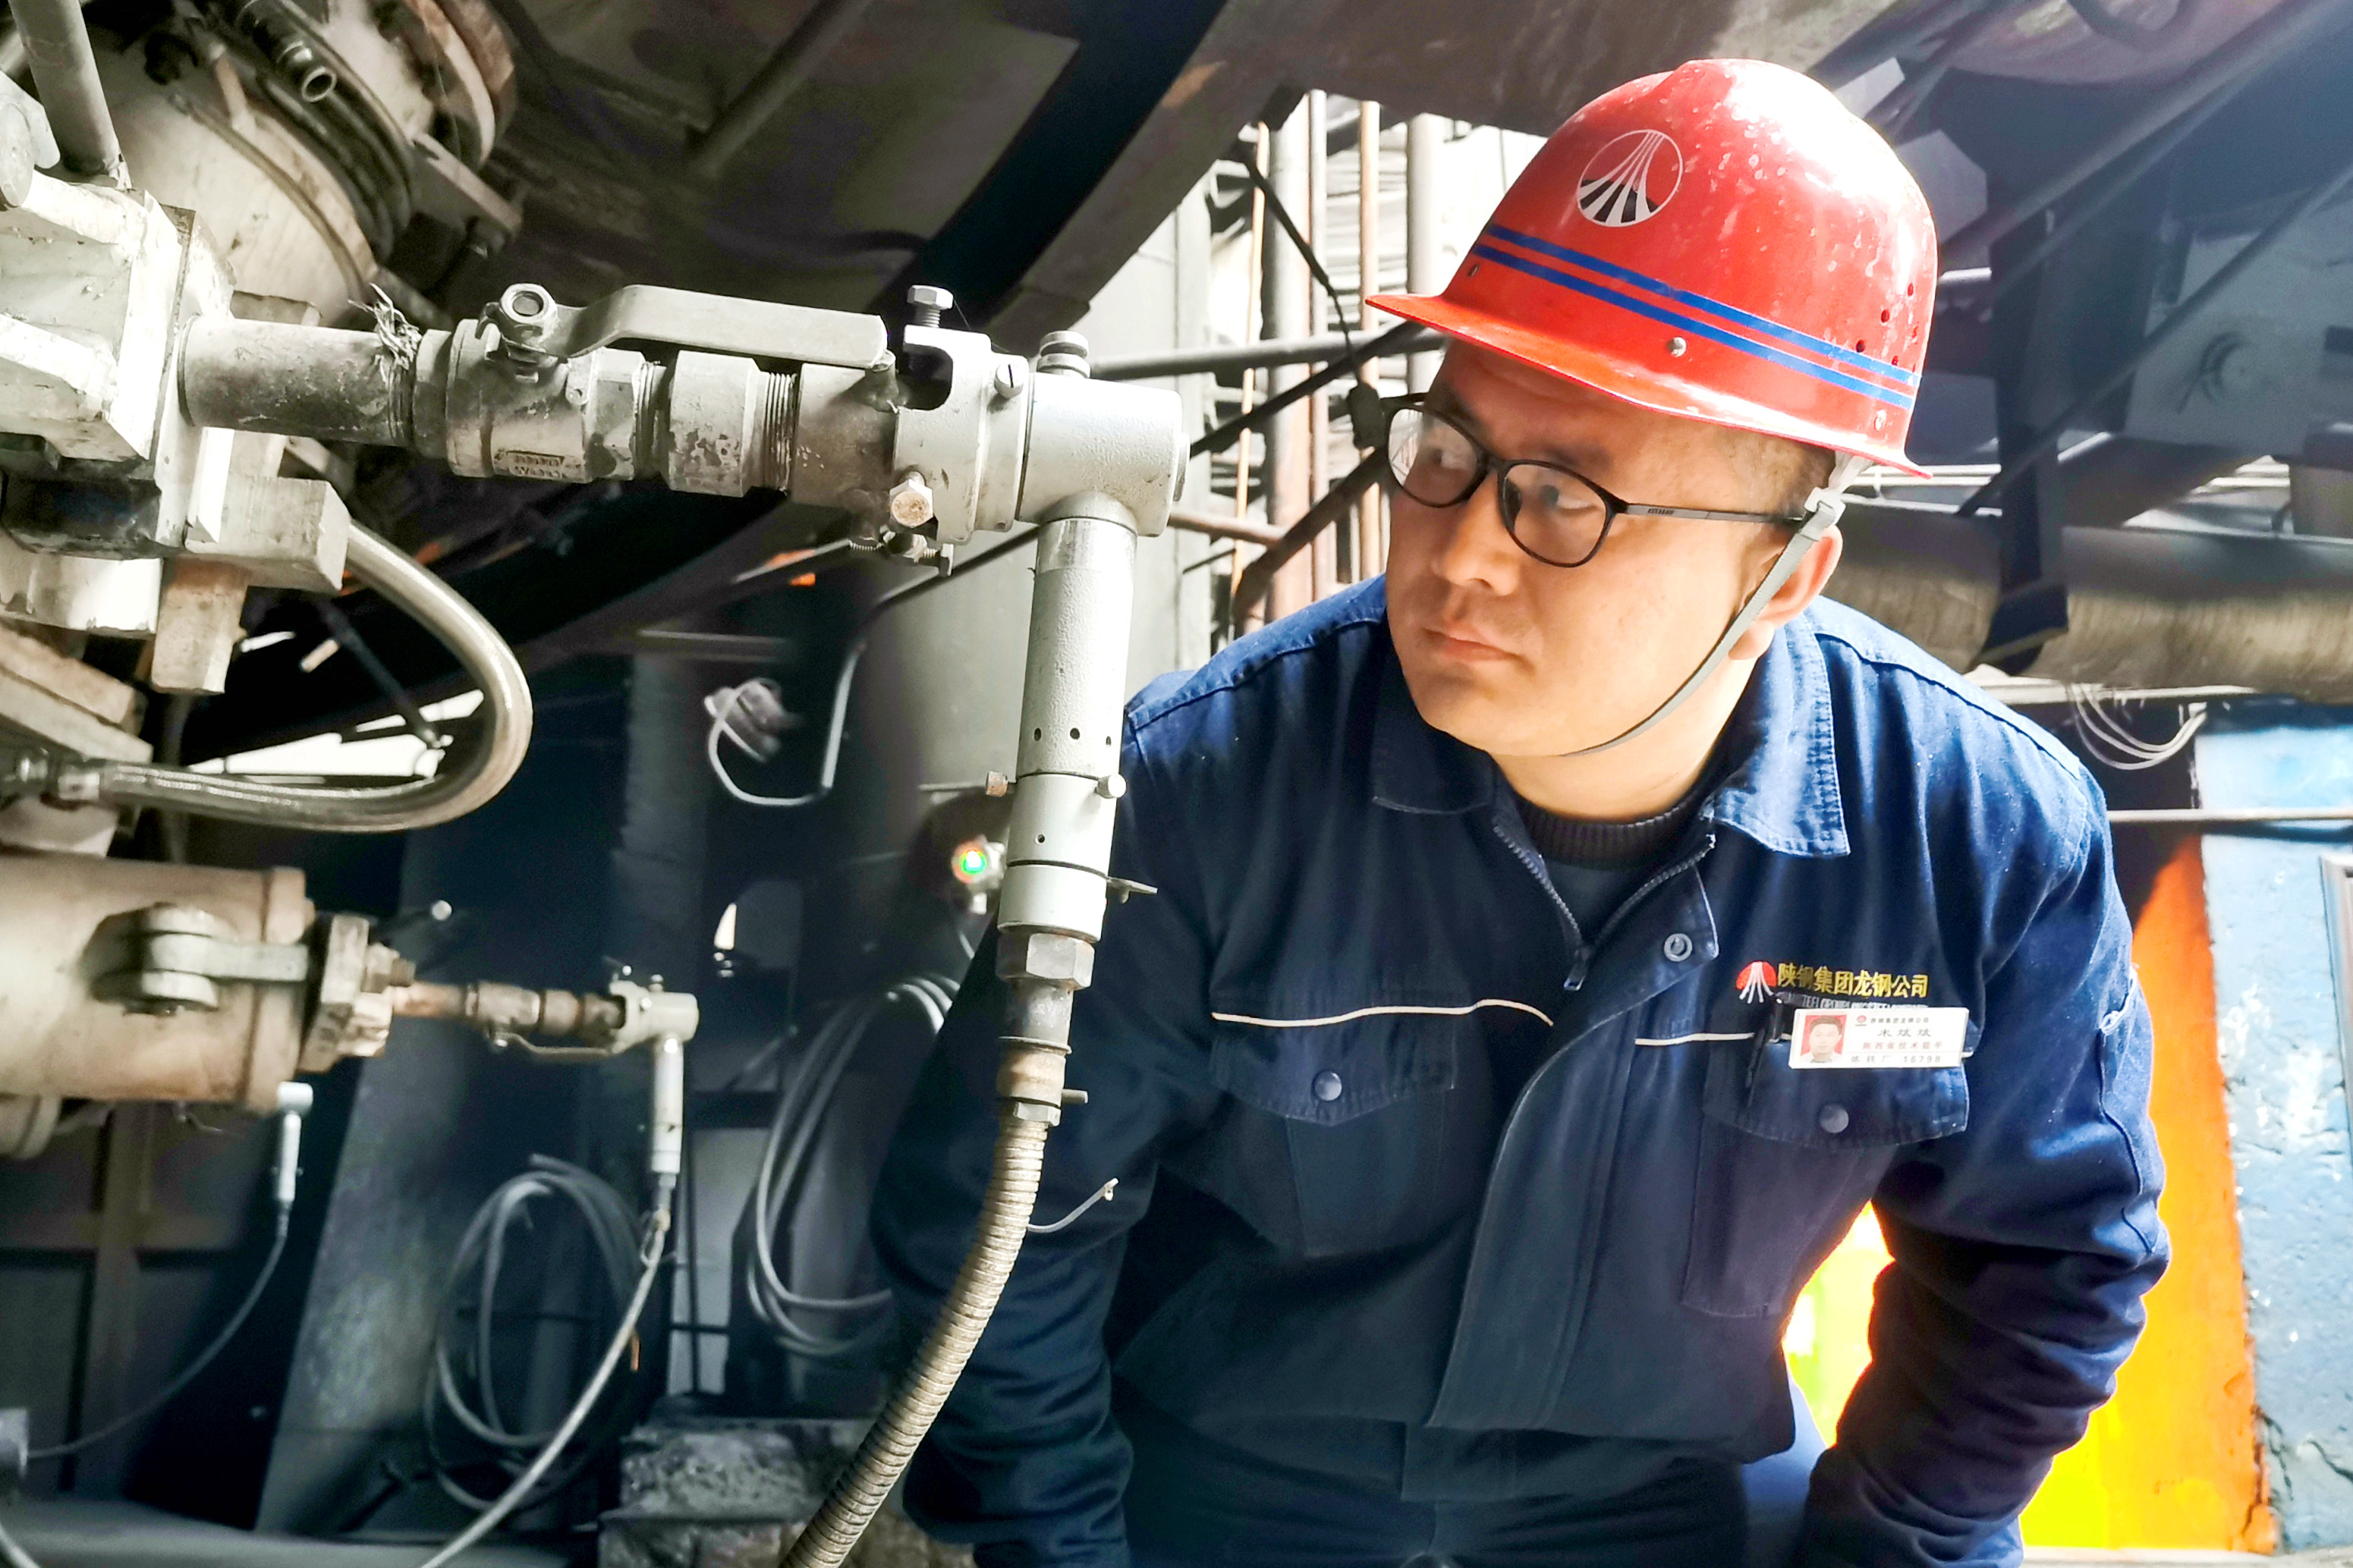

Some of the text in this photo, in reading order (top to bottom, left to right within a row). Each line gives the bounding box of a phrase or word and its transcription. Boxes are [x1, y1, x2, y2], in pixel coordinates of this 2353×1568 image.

[1777, 962, 1928, 999] 陕钢集团龙钢公司
